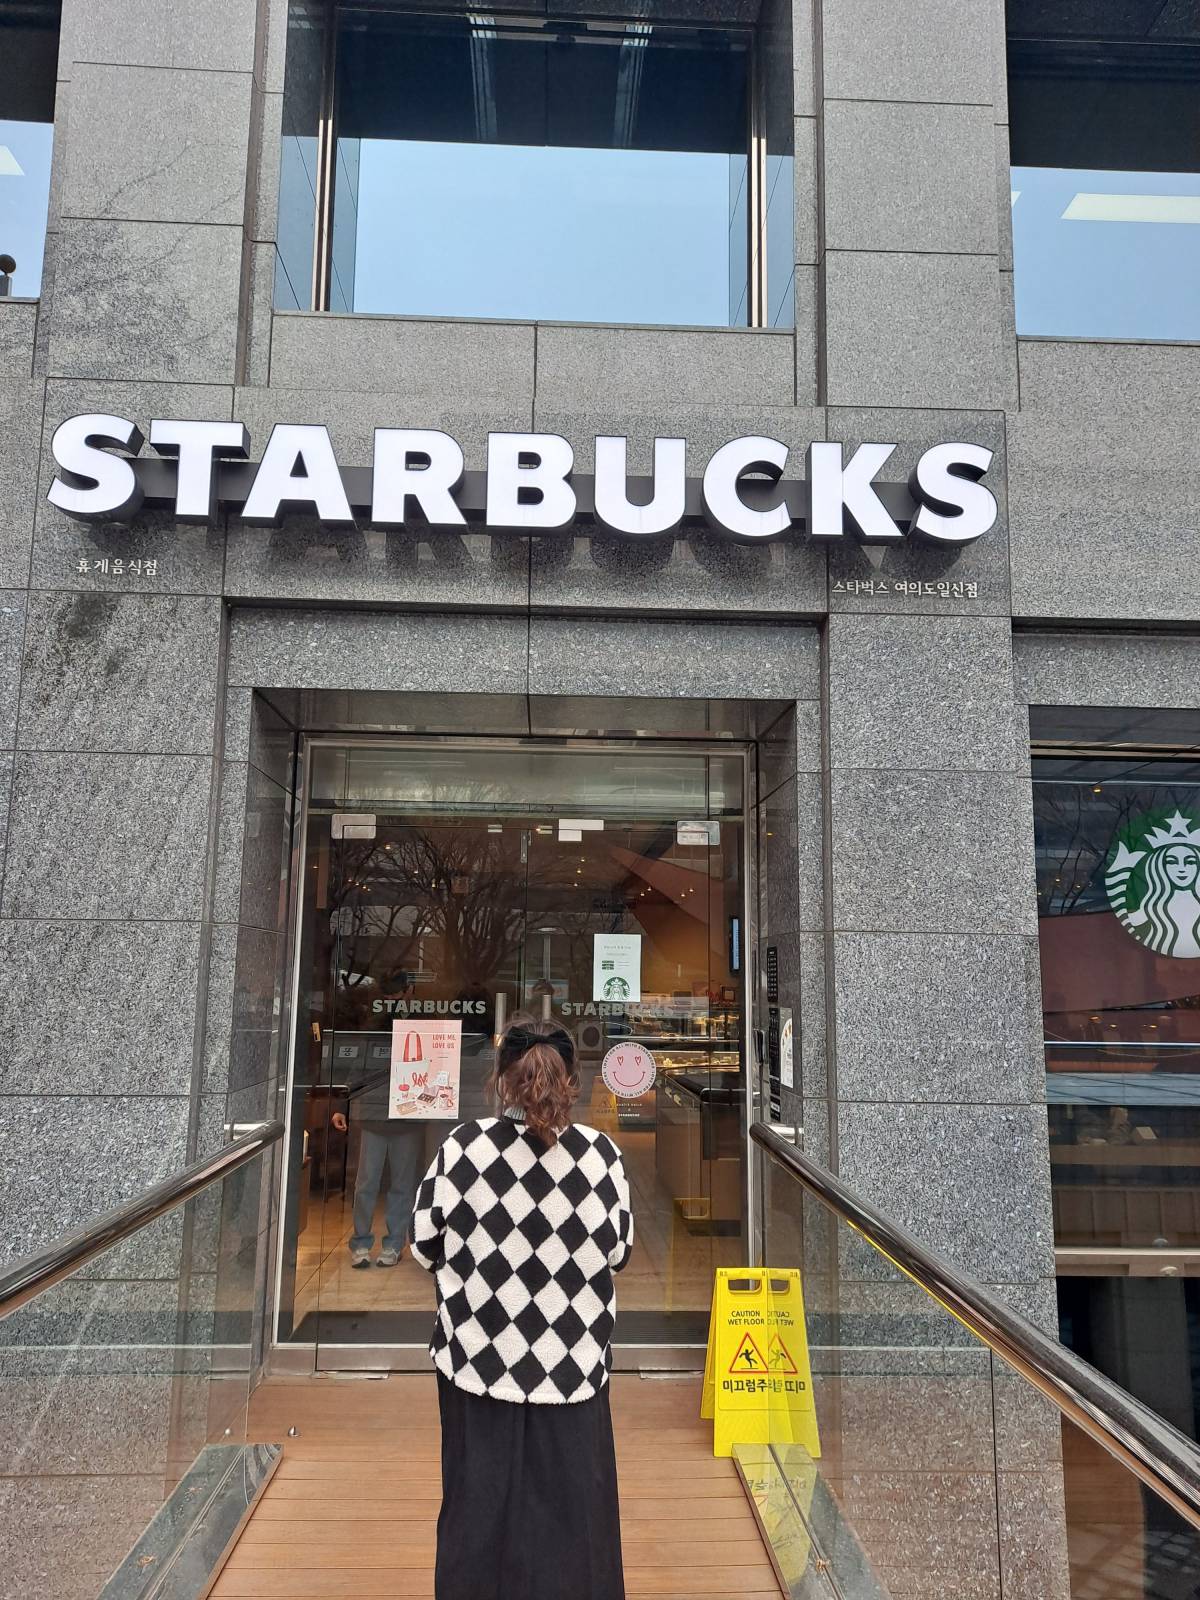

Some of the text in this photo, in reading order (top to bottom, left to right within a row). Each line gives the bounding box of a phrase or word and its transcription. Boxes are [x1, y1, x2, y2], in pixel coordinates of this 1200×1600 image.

[47, 413, 998, 541] STARBUCKS
[76, 558, 158, 576] 휴게음식점
[832, 579, 978, 598] 스타벅스 여의도일신점
[372, 999, 487, 1015] STARBUCKS
